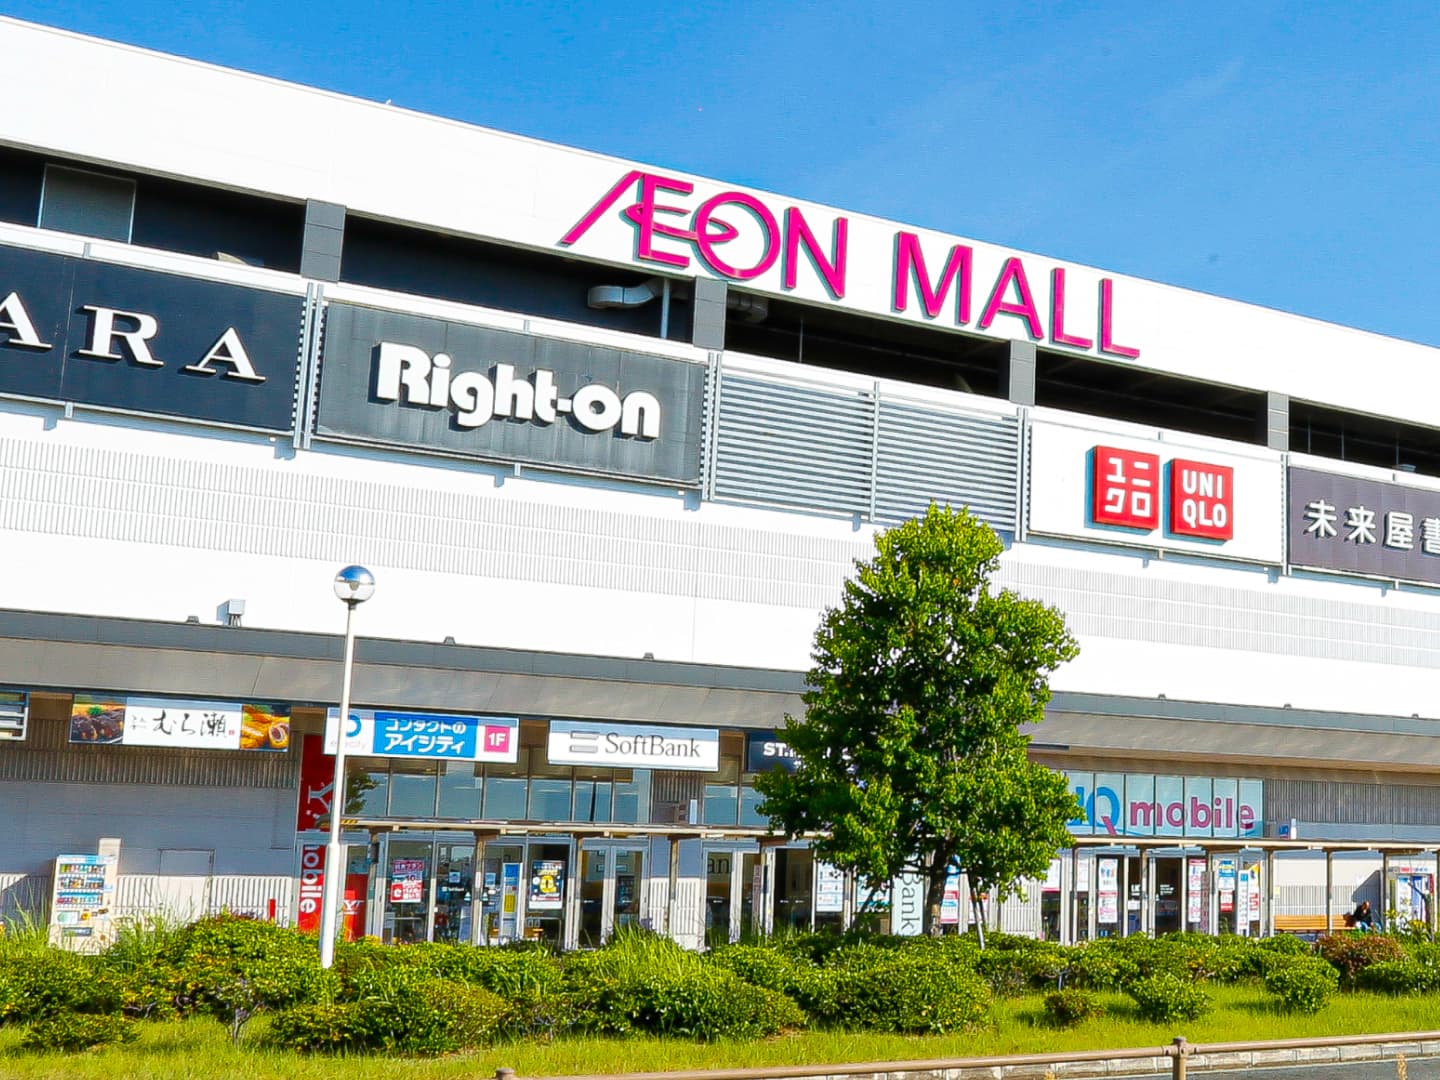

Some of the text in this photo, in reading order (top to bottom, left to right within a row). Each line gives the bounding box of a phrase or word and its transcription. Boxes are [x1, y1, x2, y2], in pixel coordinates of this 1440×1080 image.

[895, 231, 1140, 359] MALL
[376, 341, 661, 439] Right-on
[1181, 469, 1224, 499] UNI
[1181, 498, 1227, 528] QLO
[385, 718, 467, 735] コンタクトの
[488, 732, 507, 746] 1F
[384, 733, 465, 755] アイシティ
[604, 732, 702, 758] SoftBank
[1129, 796, 1255, 831] mobile
